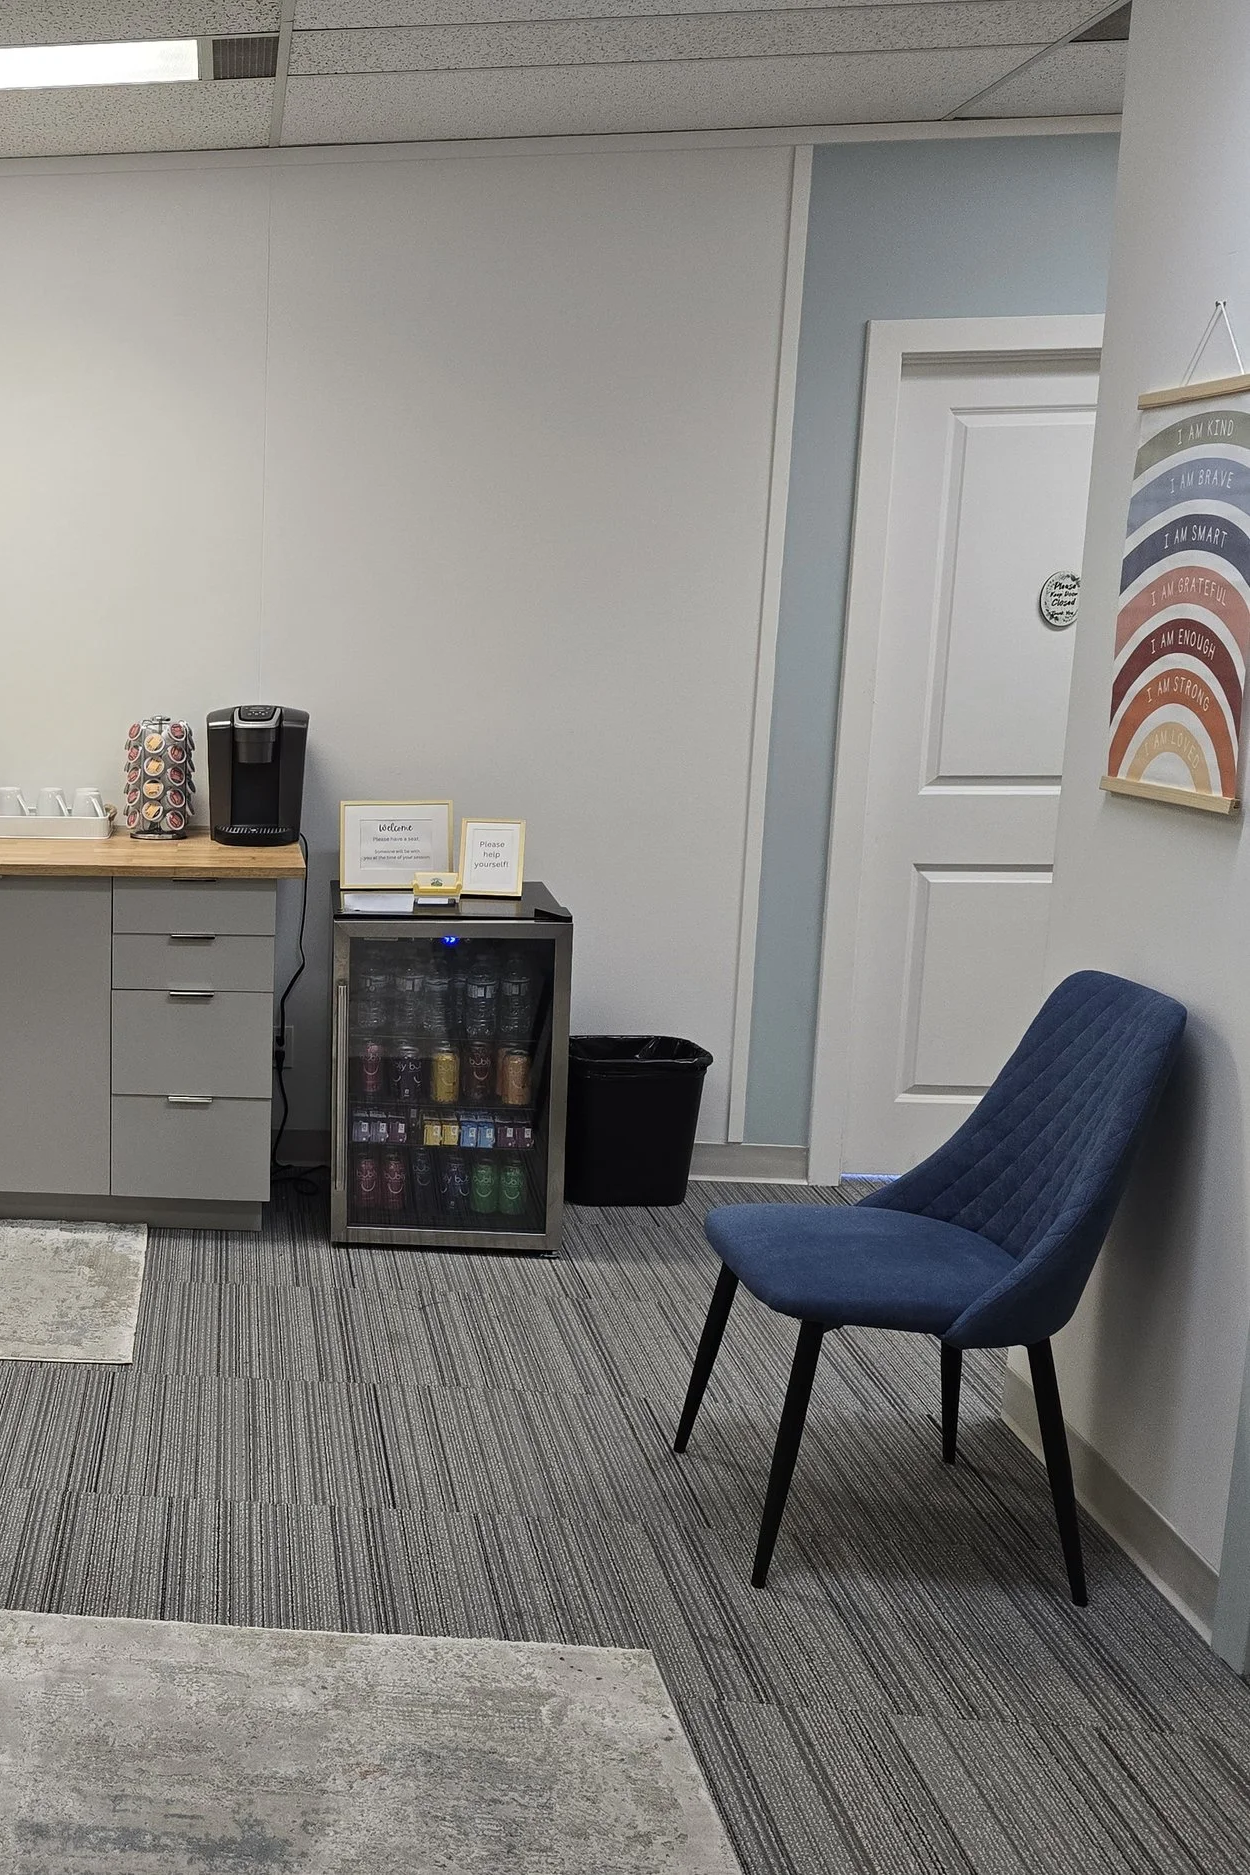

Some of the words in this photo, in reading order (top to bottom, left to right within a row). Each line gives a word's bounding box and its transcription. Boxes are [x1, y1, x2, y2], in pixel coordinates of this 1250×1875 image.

[1177, 428, 1183, 446] I
[1188, 422, 1203, 441] AM
[1207, 419, 1234, 437] KIND
[1170, 478, 1175, 494] I
[1180, 471, 1195, 490] AM
[1198, 469, 1234, 489] BRAVE
[1164, 532, 1170, 549] I
[1173, 526, 1188, 545] AM
[1191, 524, 1228, 549] SMART
[1054, 581, 1076, 590] Please
[1151, 590, 1156, 607] I
[1161, 581, 1174, 601] AM
[1178, 576, 1226, 607] GRATEFUL
[1051, 598, 1076, 606] Closed
[1151, 638, 1156, 655] I
[1160, 630, 1174, 649] AM
[1178, 628, 1216, 660] ENOUGH
[1146, 687, 1153, 703] I
[1157, 677, 1170, 697] AM
[1173, 676, 1210, 712] STRONG
[1144, 742, 1150, 756] I
[1153, 730, 1168, 750] AM
[1170, 728, 1200, 769] LOVED
[378, 822, 414, 832] Welcome
[479, 840, 505, 848] Please
[483, 851, 501, 859] help
[474, 860, 509, 870] yourself!
